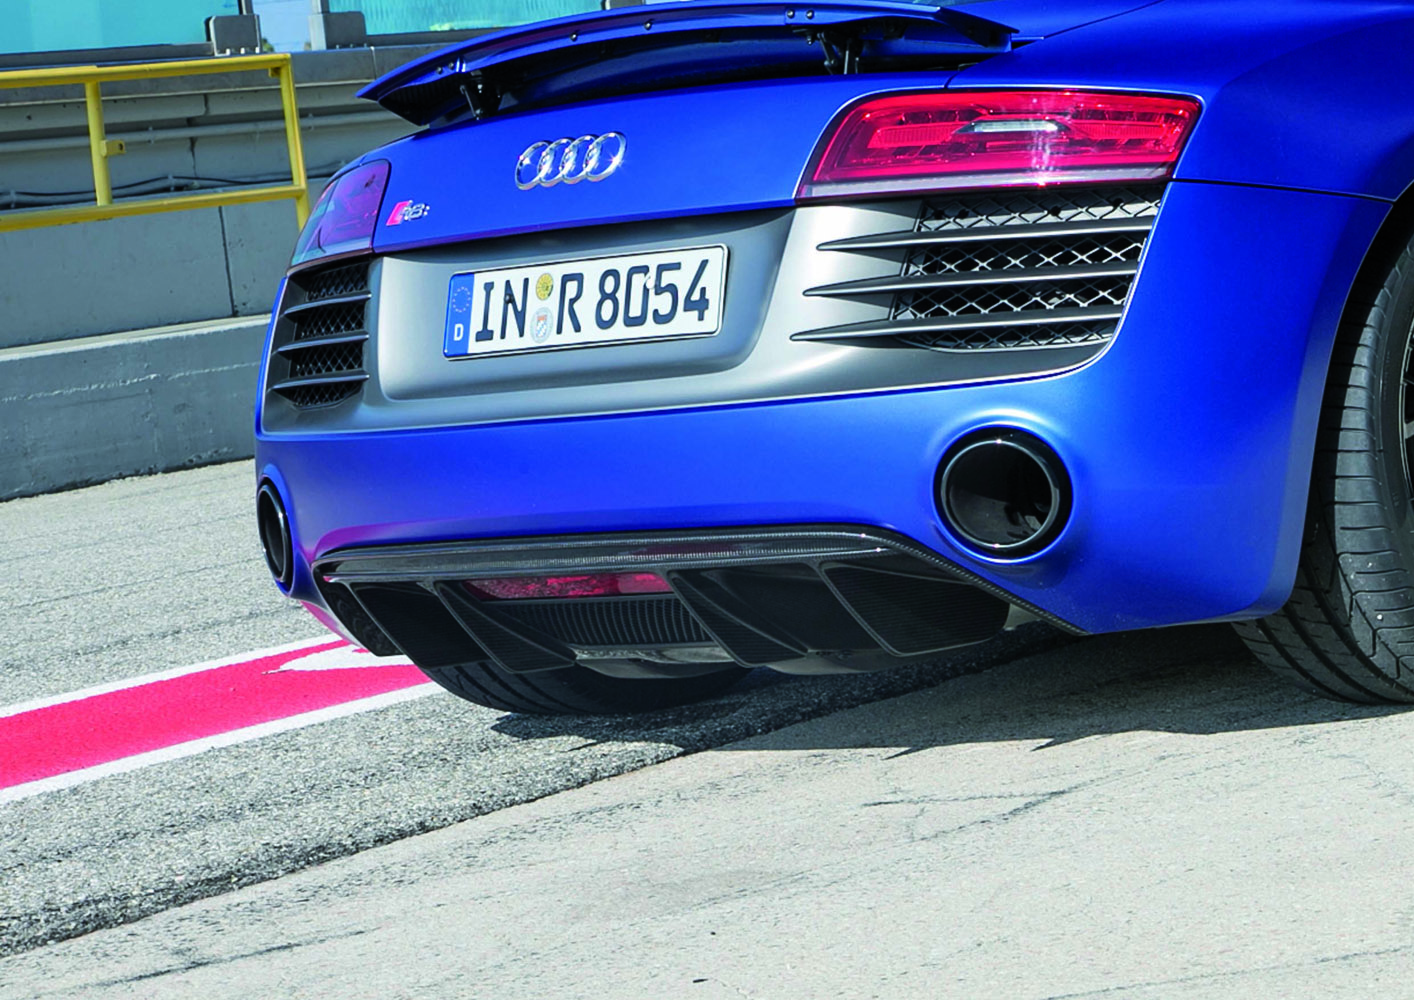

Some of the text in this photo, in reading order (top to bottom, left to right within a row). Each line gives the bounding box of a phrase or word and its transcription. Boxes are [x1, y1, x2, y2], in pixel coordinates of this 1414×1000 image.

[475, 258, 710, 342] IN R 8054
[453, 323, 464, 341] D
